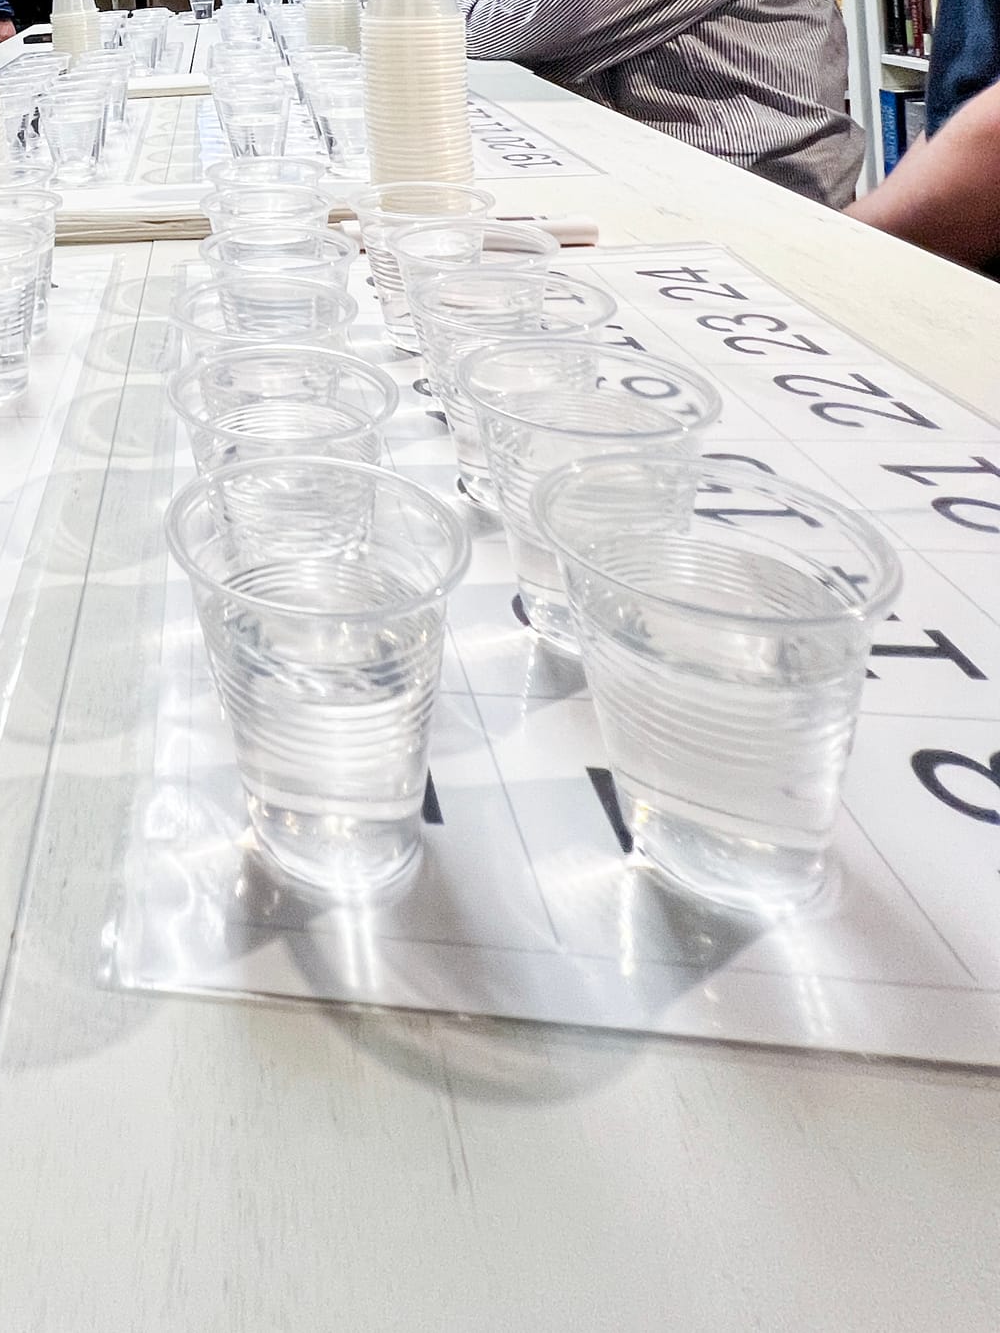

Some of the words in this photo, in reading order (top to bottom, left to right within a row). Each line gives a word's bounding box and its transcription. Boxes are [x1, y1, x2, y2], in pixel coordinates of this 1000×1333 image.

[502, 153, 563, 170] 19
[634, 266, 749, 302] 24
[696, 312, 832, 356] 23
[772, 372, 943, 431] 22
